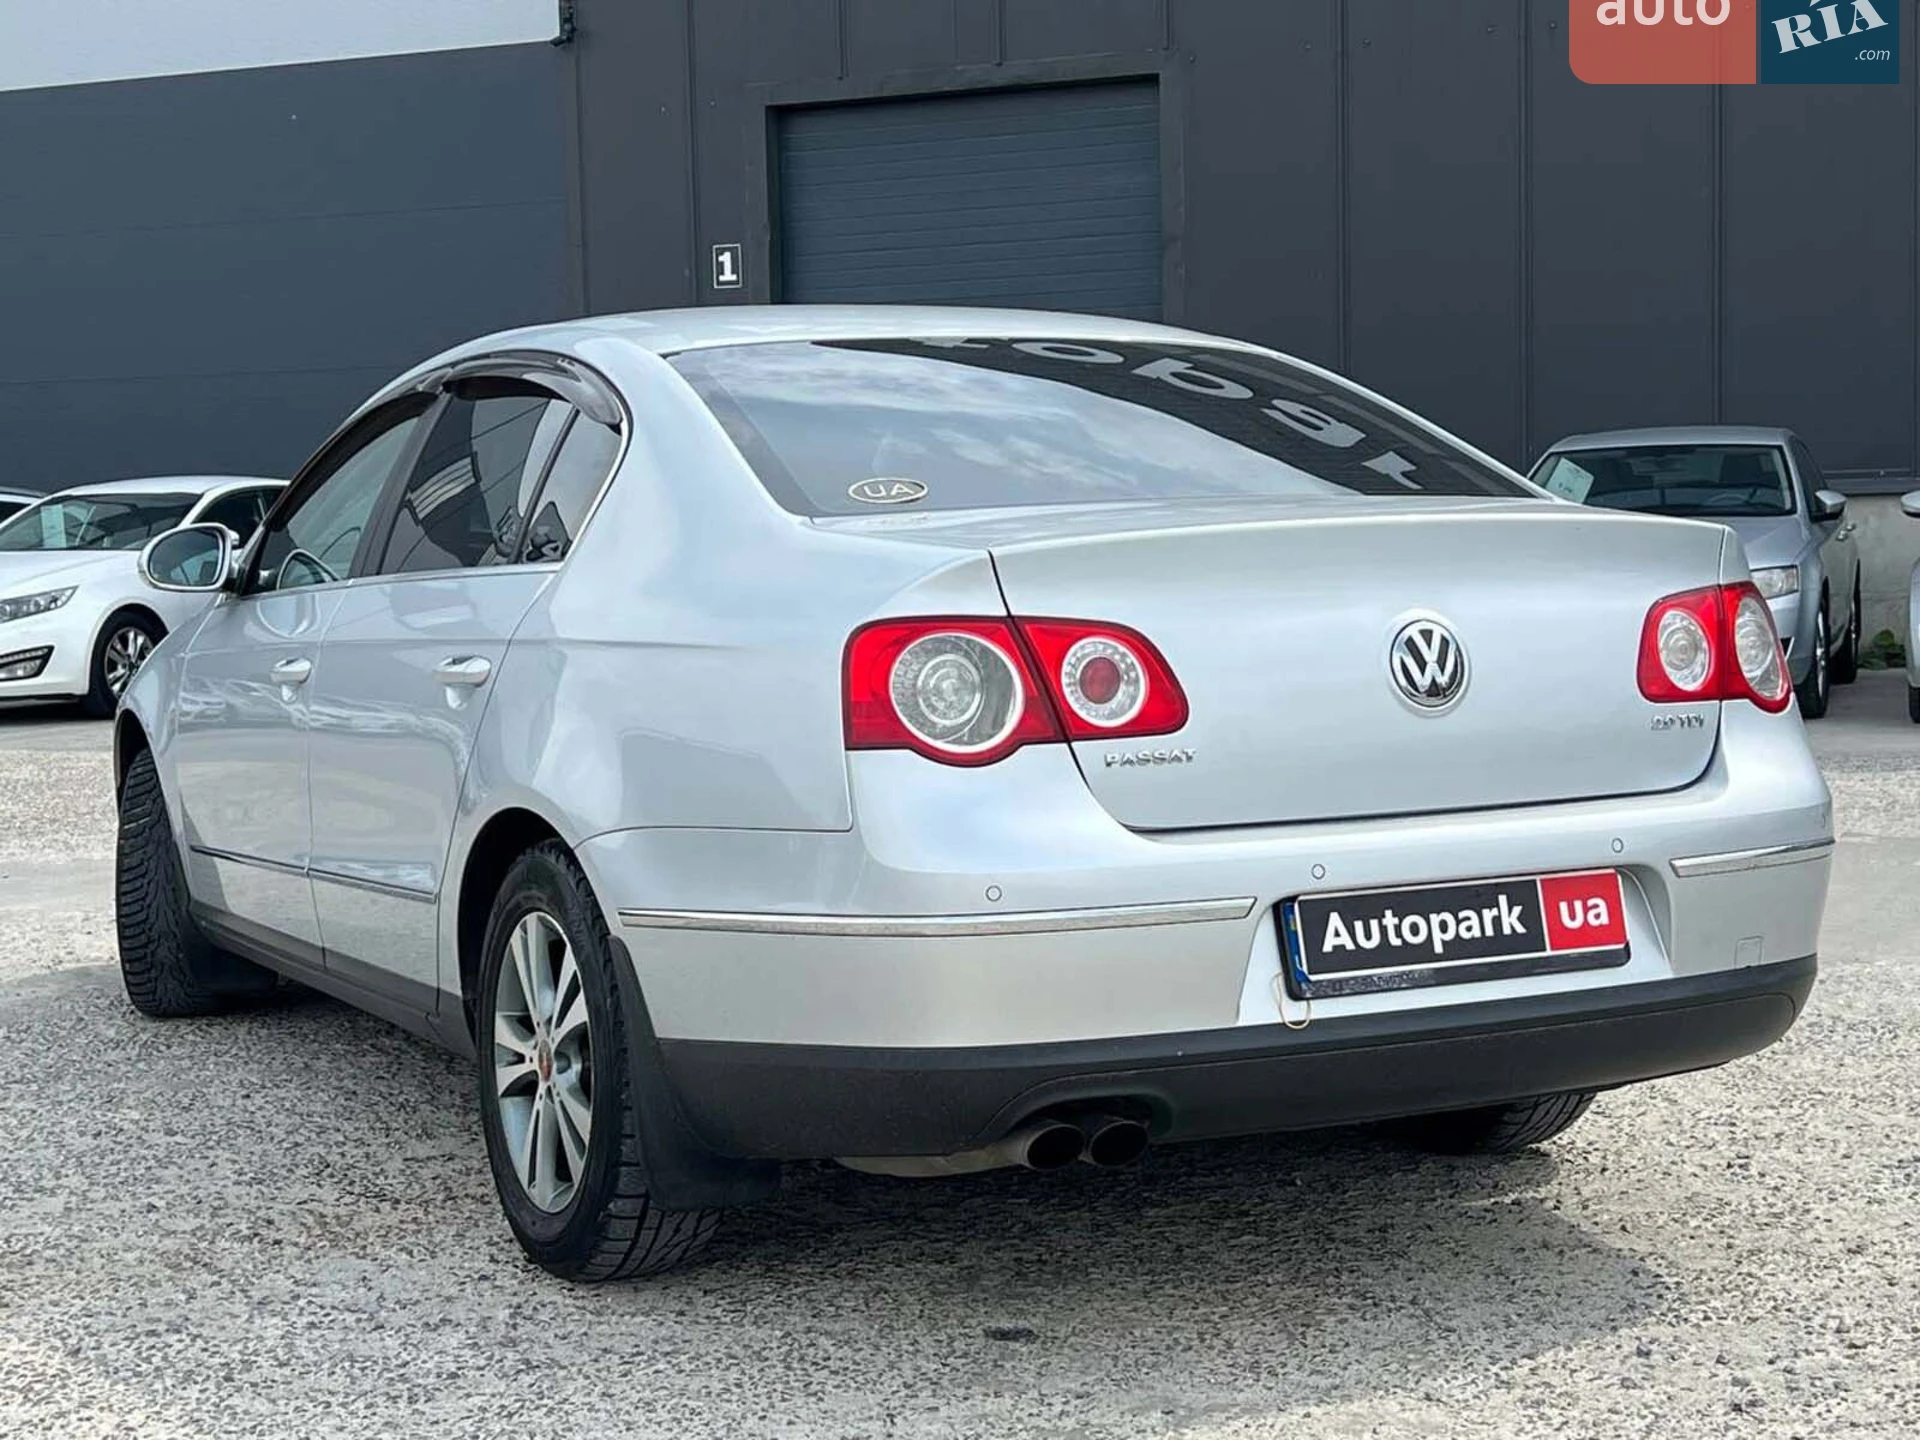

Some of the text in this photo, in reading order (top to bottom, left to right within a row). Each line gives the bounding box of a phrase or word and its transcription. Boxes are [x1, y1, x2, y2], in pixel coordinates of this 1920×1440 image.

[718, 251, 738, 281] 1
[863, 483, 915, 497] UA
[1104, 748, 1196, 767] PASSAT
[1322, 895, 1609, 953] Autopark ua
